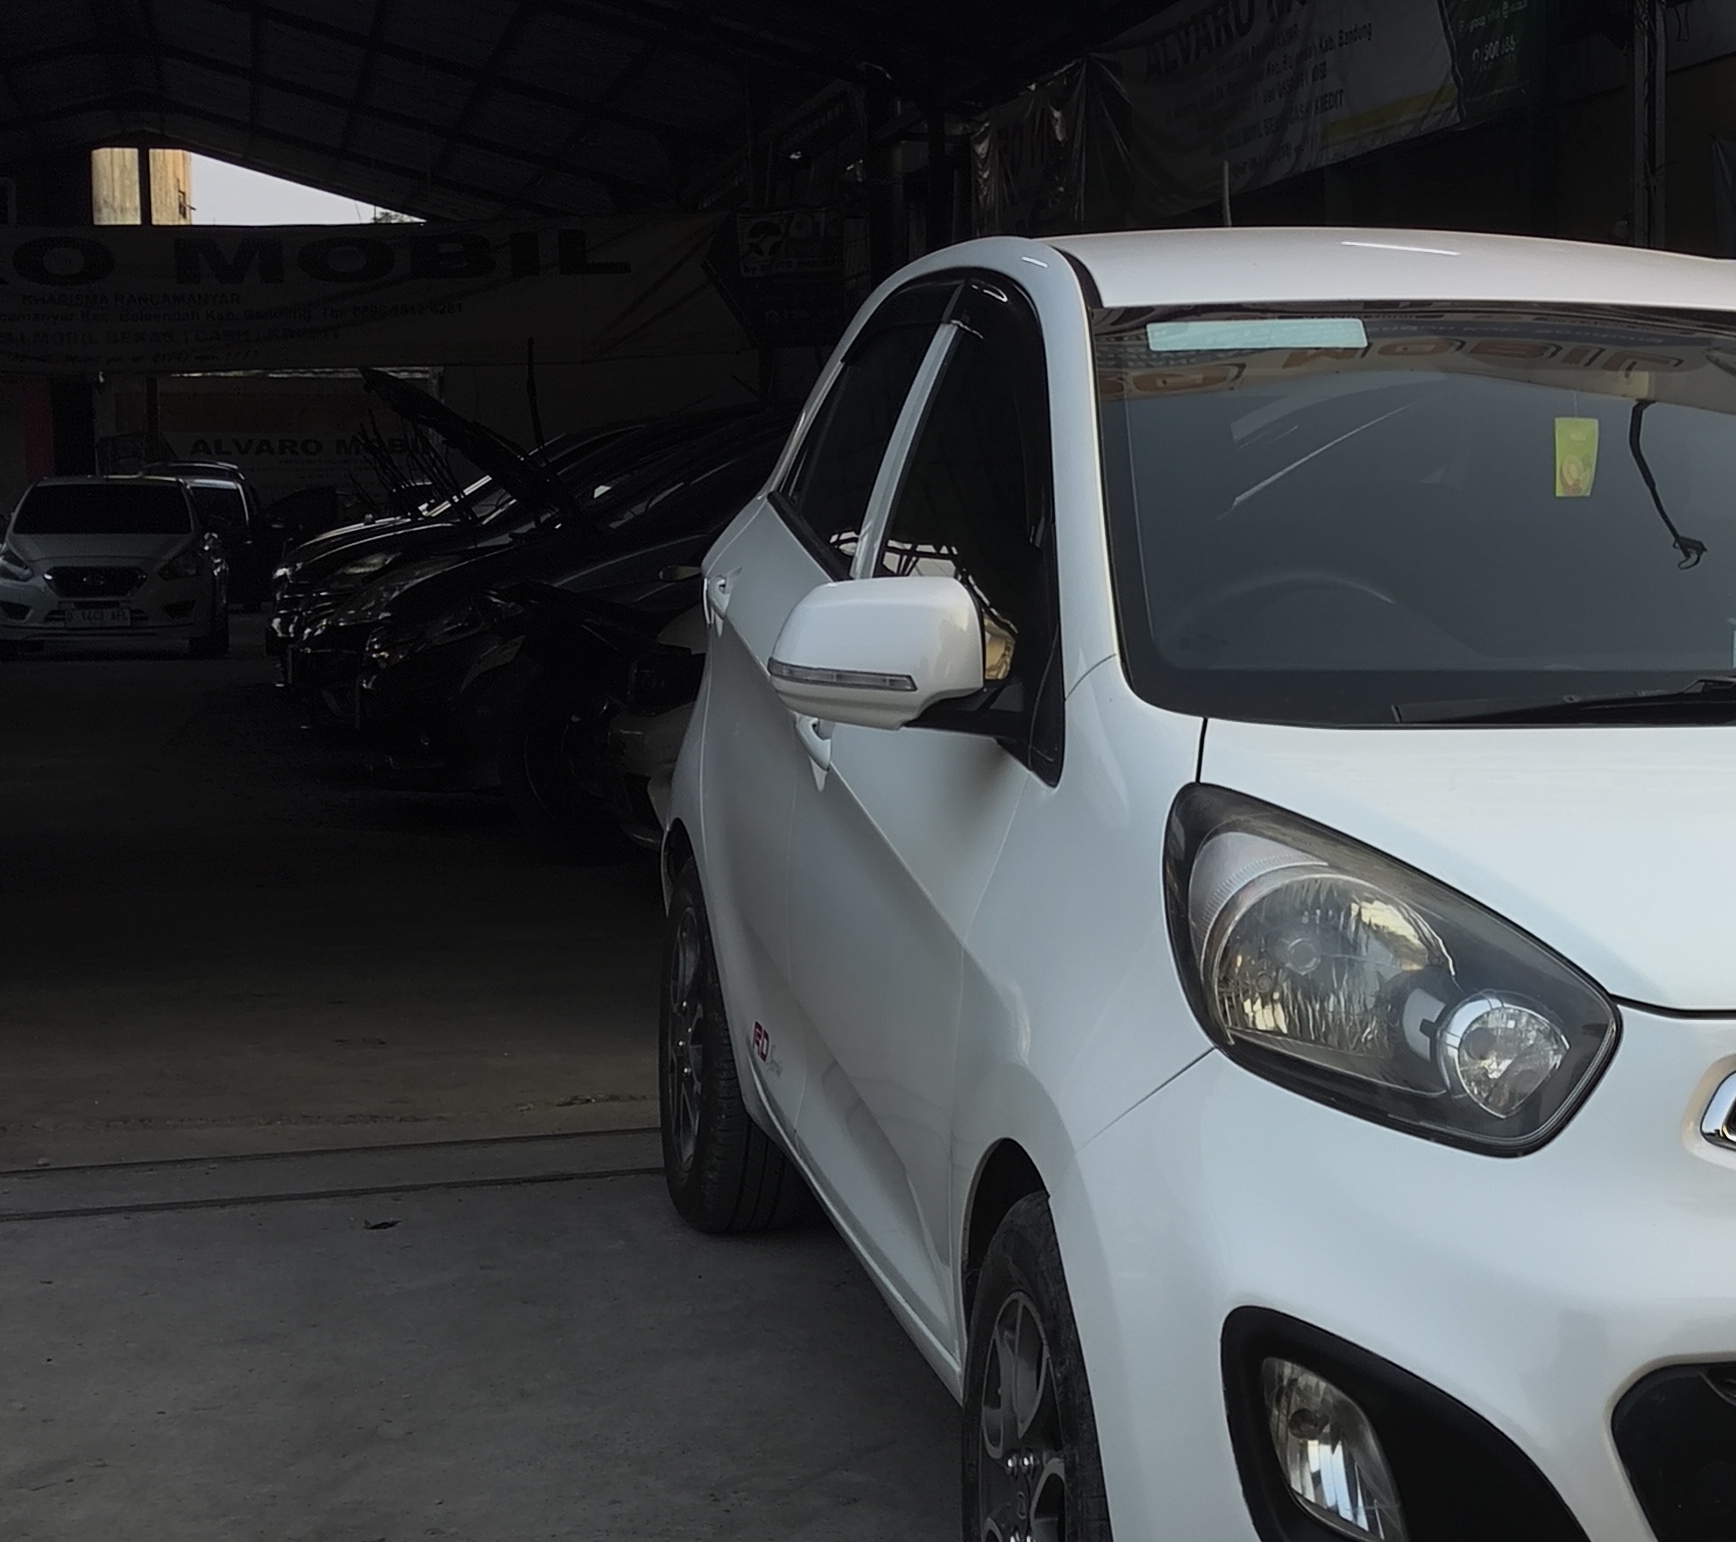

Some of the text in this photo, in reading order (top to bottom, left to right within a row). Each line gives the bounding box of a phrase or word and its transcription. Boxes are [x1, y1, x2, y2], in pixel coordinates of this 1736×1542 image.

[0, 228, 631, 287] O MOBIL
[190, 438, 323, 456] ALVARO
